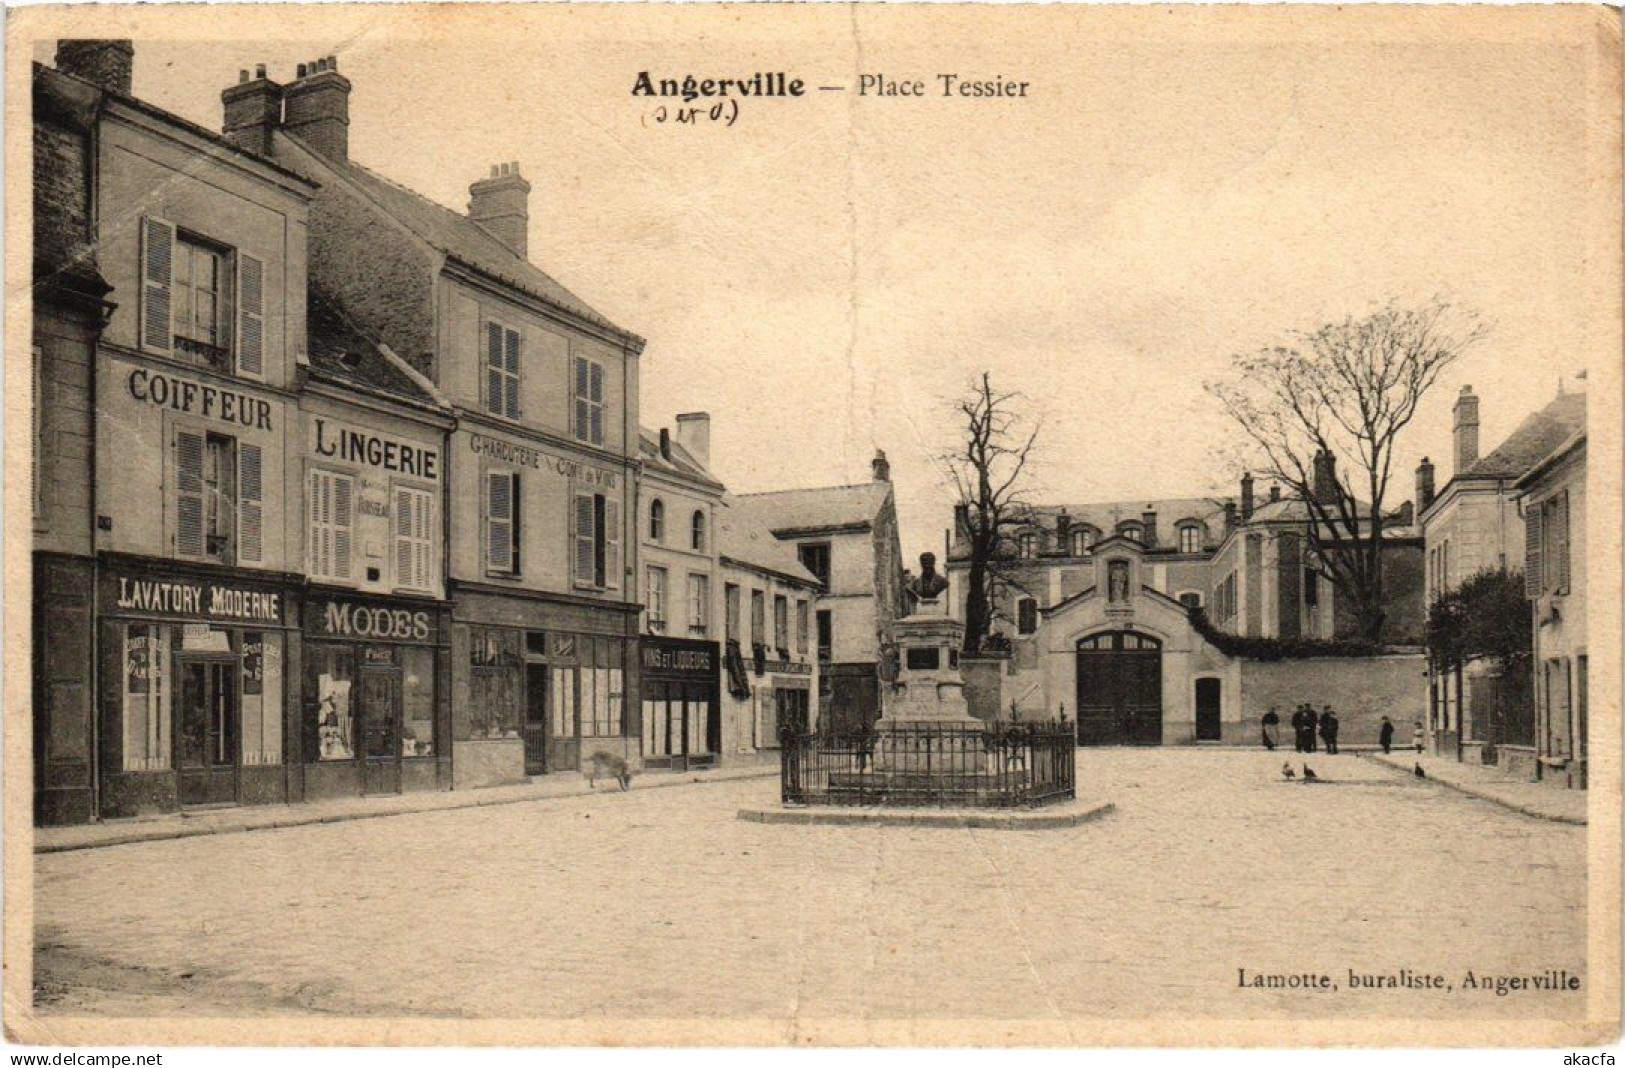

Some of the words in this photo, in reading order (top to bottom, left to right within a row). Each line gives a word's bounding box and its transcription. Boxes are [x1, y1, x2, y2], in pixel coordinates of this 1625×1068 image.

[128, 369, 273, 432] COIFFEUR
[314, 419, 438, 480] LINGERIE
[470, 433, 540, 469] CHARCUTERIE
[117, 576, 202, 613] LAVATORY
[208, 586, 279, 620] MODERNE
[324, 602, 430, 640] MODES
